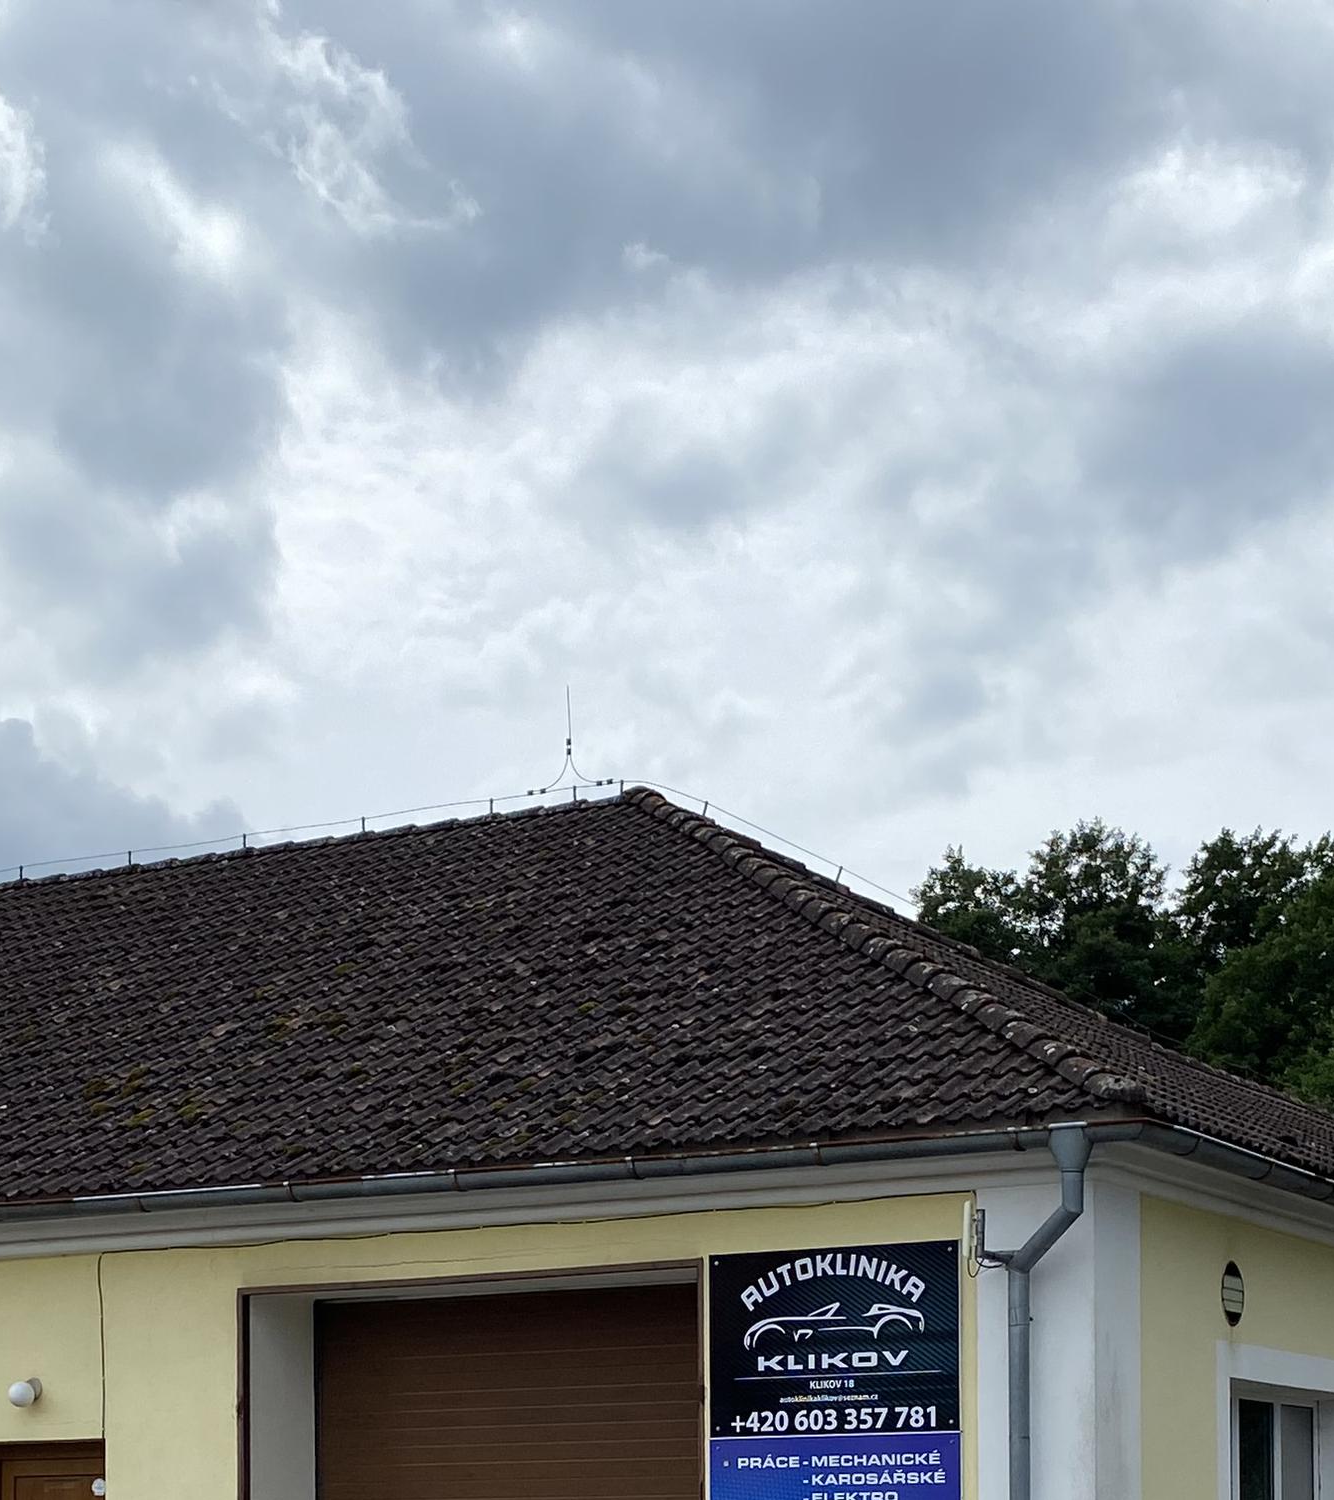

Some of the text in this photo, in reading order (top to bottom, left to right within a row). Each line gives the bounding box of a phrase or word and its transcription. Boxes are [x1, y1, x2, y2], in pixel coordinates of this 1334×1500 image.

[741, 1253, 926, 1312] AUTOKLINIKA
[757, 1350, 909, 1372] KLIKOV
[809, 1379, 855, 1389] KLIKOV 18
[731, 1405, 937, 1433] +420 603 357 781
[737, 1454, 800, 1469] PRÁCE
[811, 1449, 941, 1467] MECHANICKÉ
[811, 1468, 946, 1486] KAROSÁŘSKÉ
